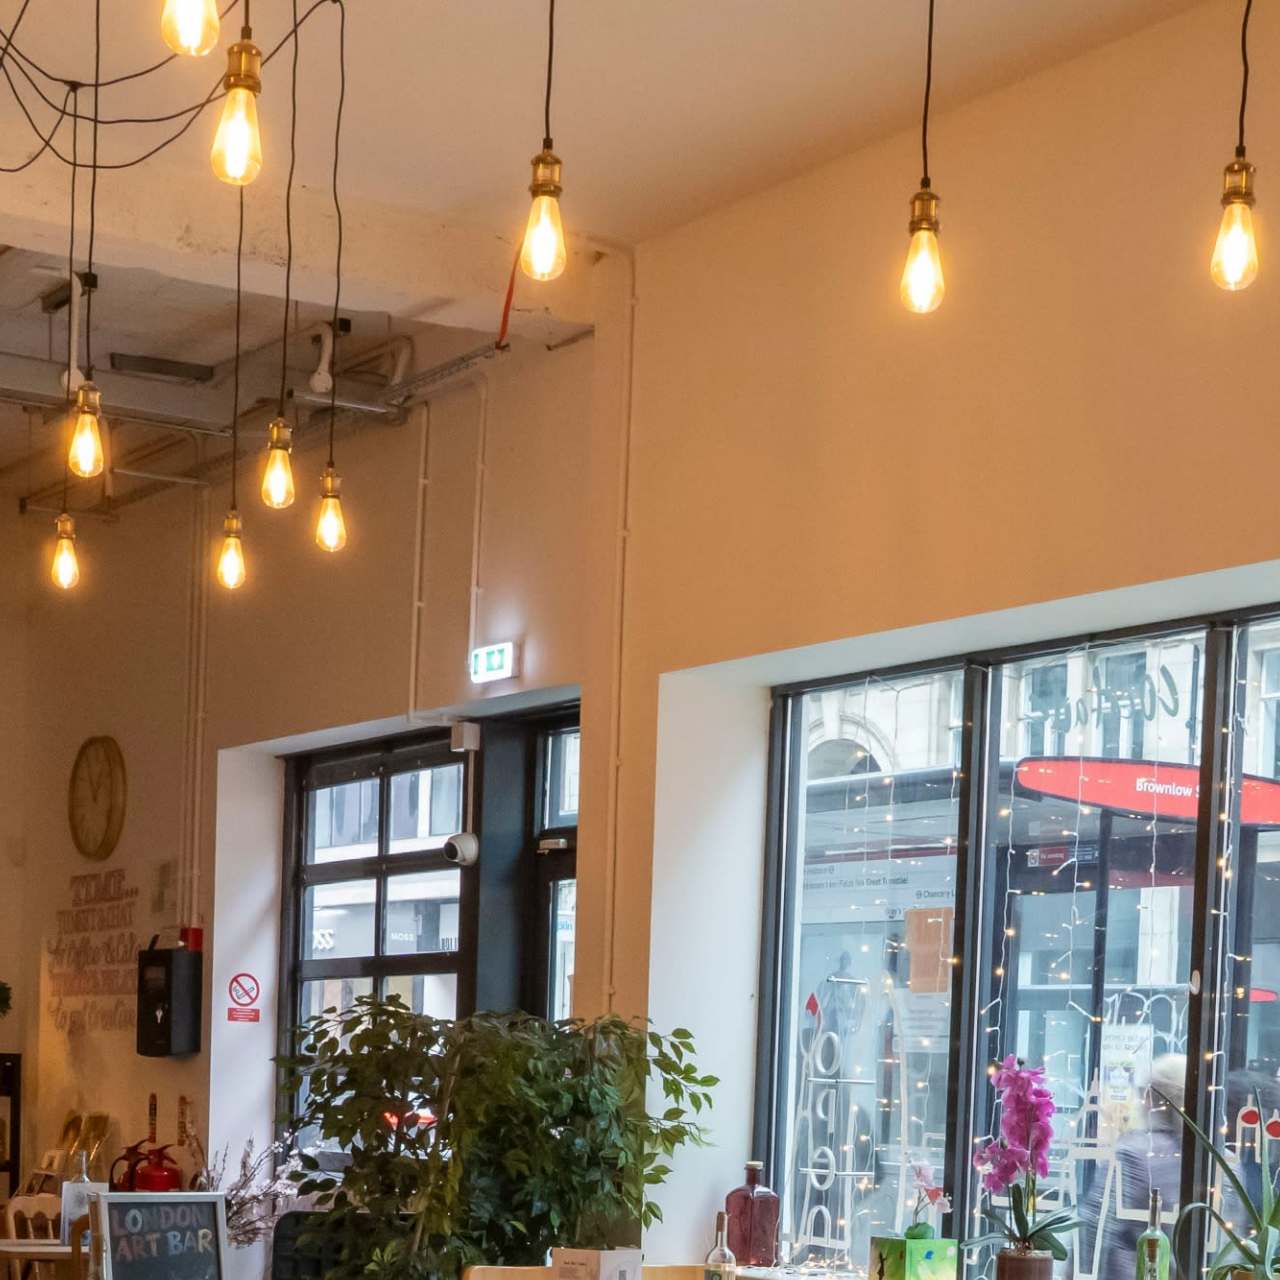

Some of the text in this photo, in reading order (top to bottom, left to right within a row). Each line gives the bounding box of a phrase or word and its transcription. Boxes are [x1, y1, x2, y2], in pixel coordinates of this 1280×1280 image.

[1136, 778, 1193, 797] Brownlow
[110, 1205, 208, 1235] LONDON
[116, 1228, 214, 1263] ART BAR
